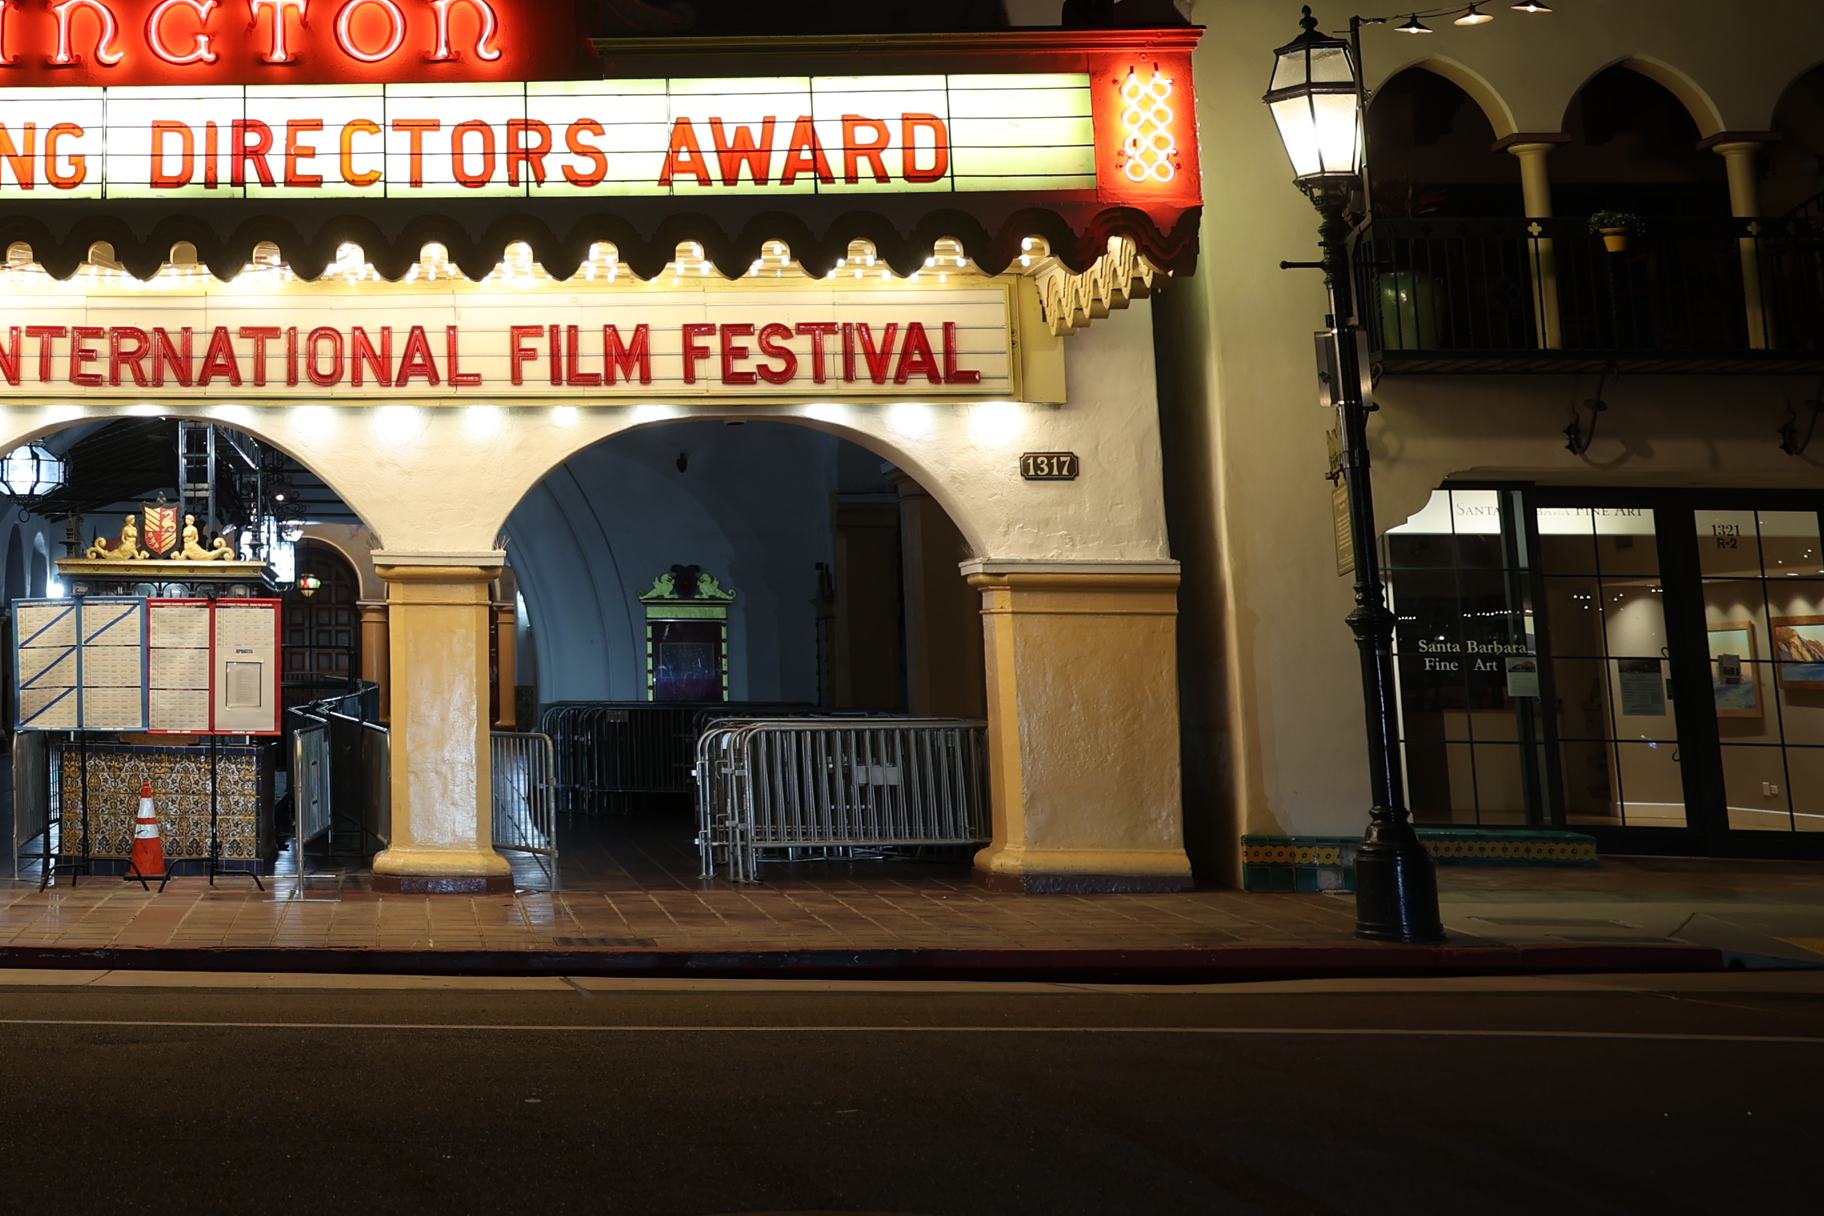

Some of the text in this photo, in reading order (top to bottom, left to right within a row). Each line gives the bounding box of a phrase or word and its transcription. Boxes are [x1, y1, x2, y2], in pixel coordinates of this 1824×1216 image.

[151, 117, 609, 190] DIRECTORS
[659, 112, 949, 186] AWARD
[509, 323, 652, 386] FILM
[681, 321, 982, 385] FESTIVAL
[1026, 456, 1071, 476] 1317
[1711, 524, 1740, 536] 1321
[1418, 639, 1527, 654] Santa Barbara
[1423, 657, 1498, 671] Fine Art
